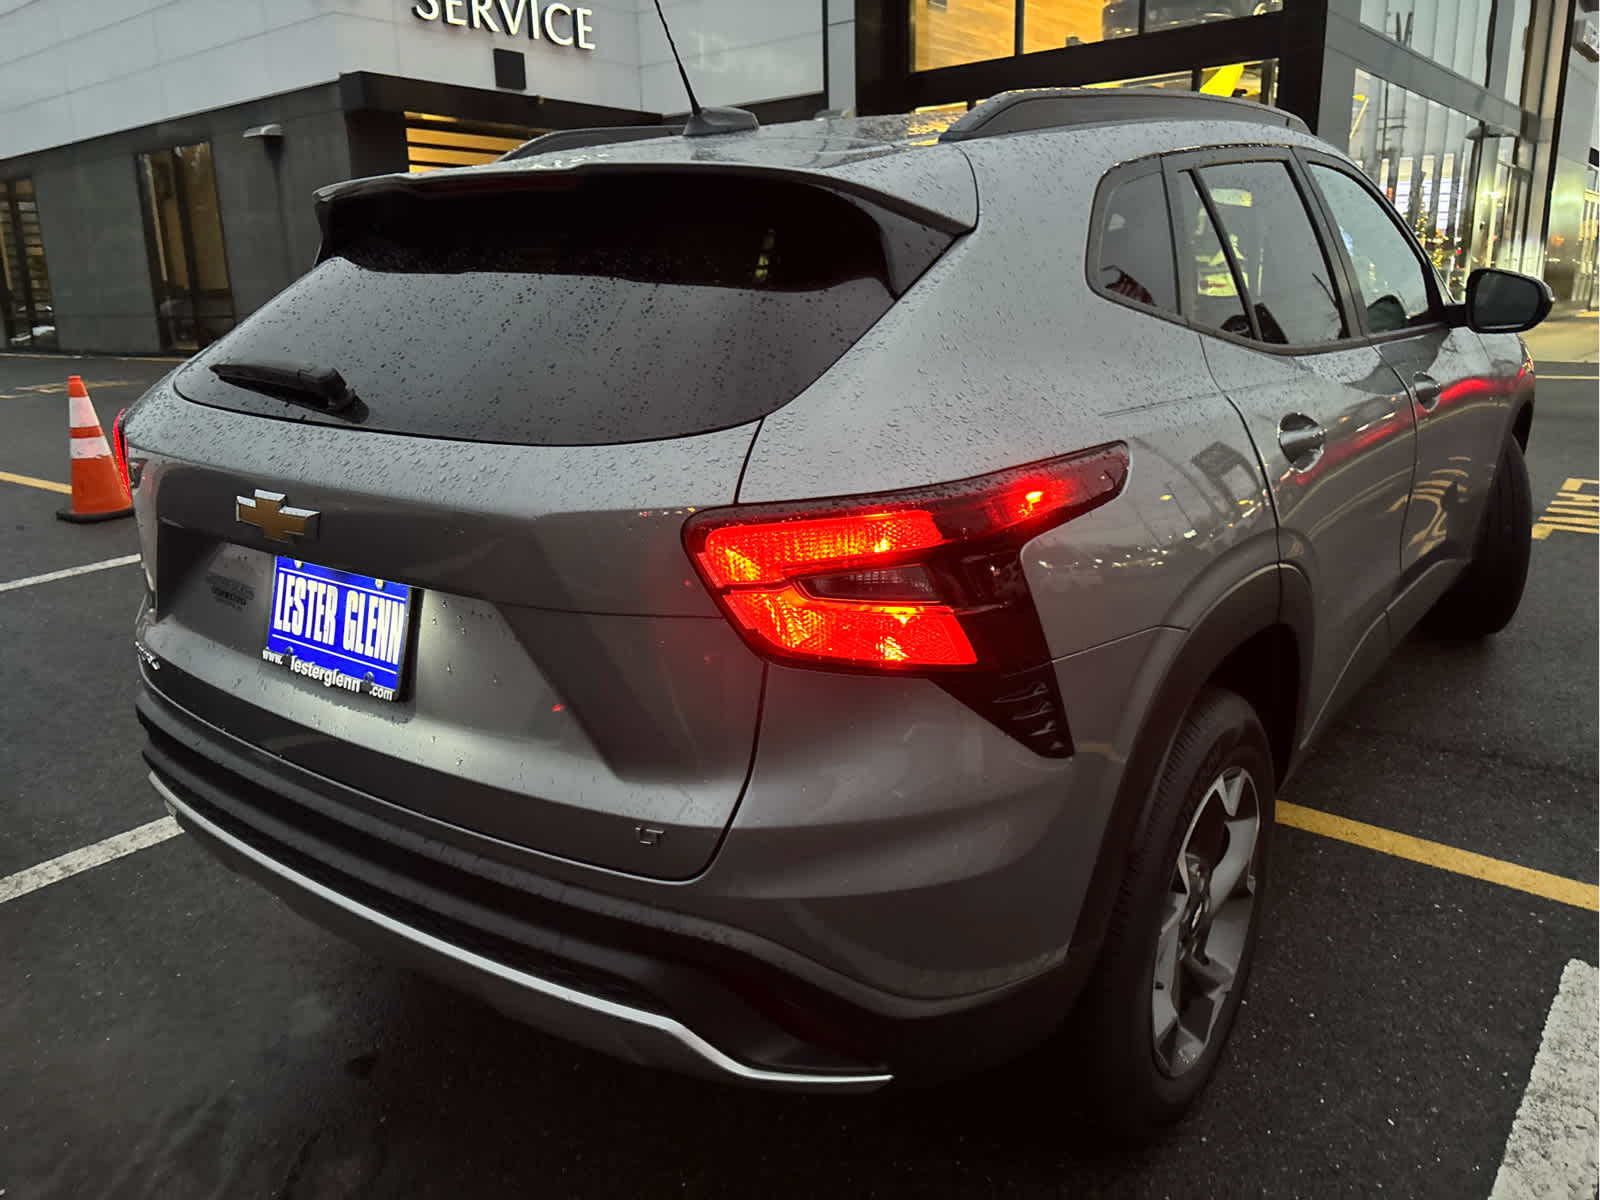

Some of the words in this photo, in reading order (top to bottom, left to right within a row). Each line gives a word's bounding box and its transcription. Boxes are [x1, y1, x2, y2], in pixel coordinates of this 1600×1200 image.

[273, 572, 338, 646] LESTER
[342, 590, 406, 665] GLENN
[290, 655, 361, 693] lesterglenn
[369, 685, 393, 701] .com
